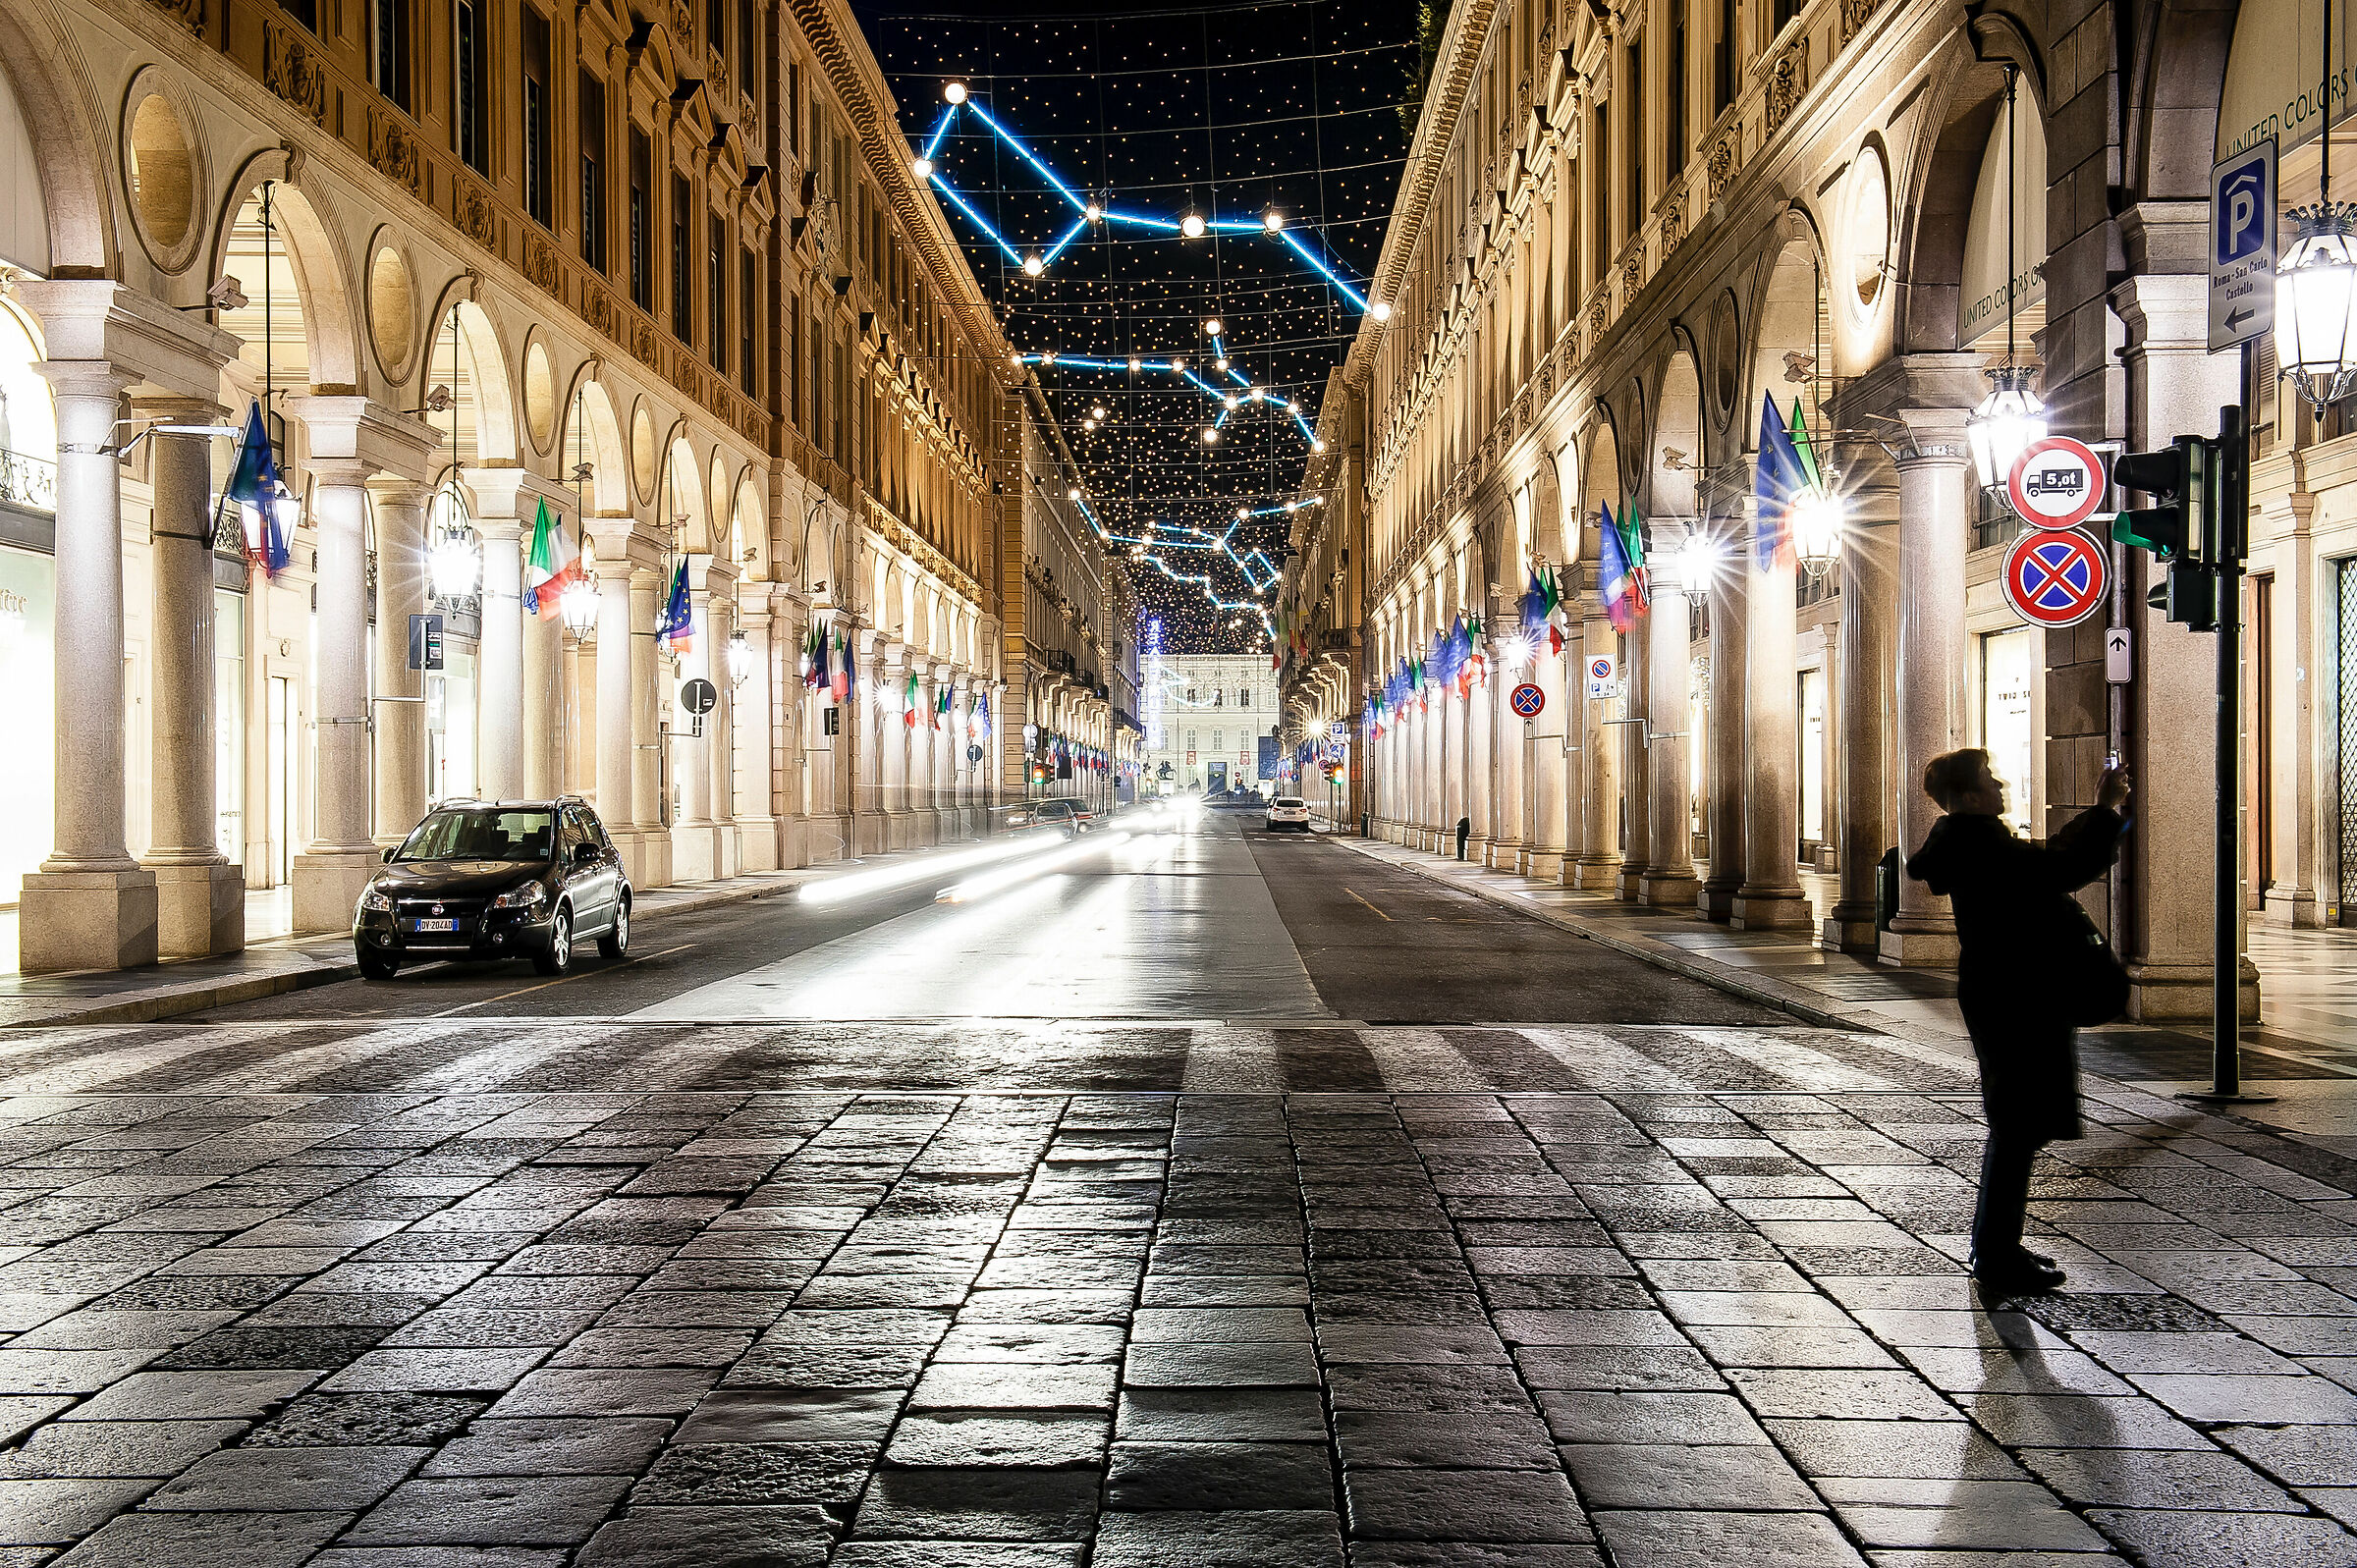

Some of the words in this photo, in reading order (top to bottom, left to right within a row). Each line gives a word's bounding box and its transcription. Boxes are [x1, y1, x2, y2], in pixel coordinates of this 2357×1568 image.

[2230, 190, 2254, 255] P
[2249, 256, 2268, 274] Carlo
[2226, 281, 2254, 301] Castello
[1964, 295, 1993, 329] UNITED
